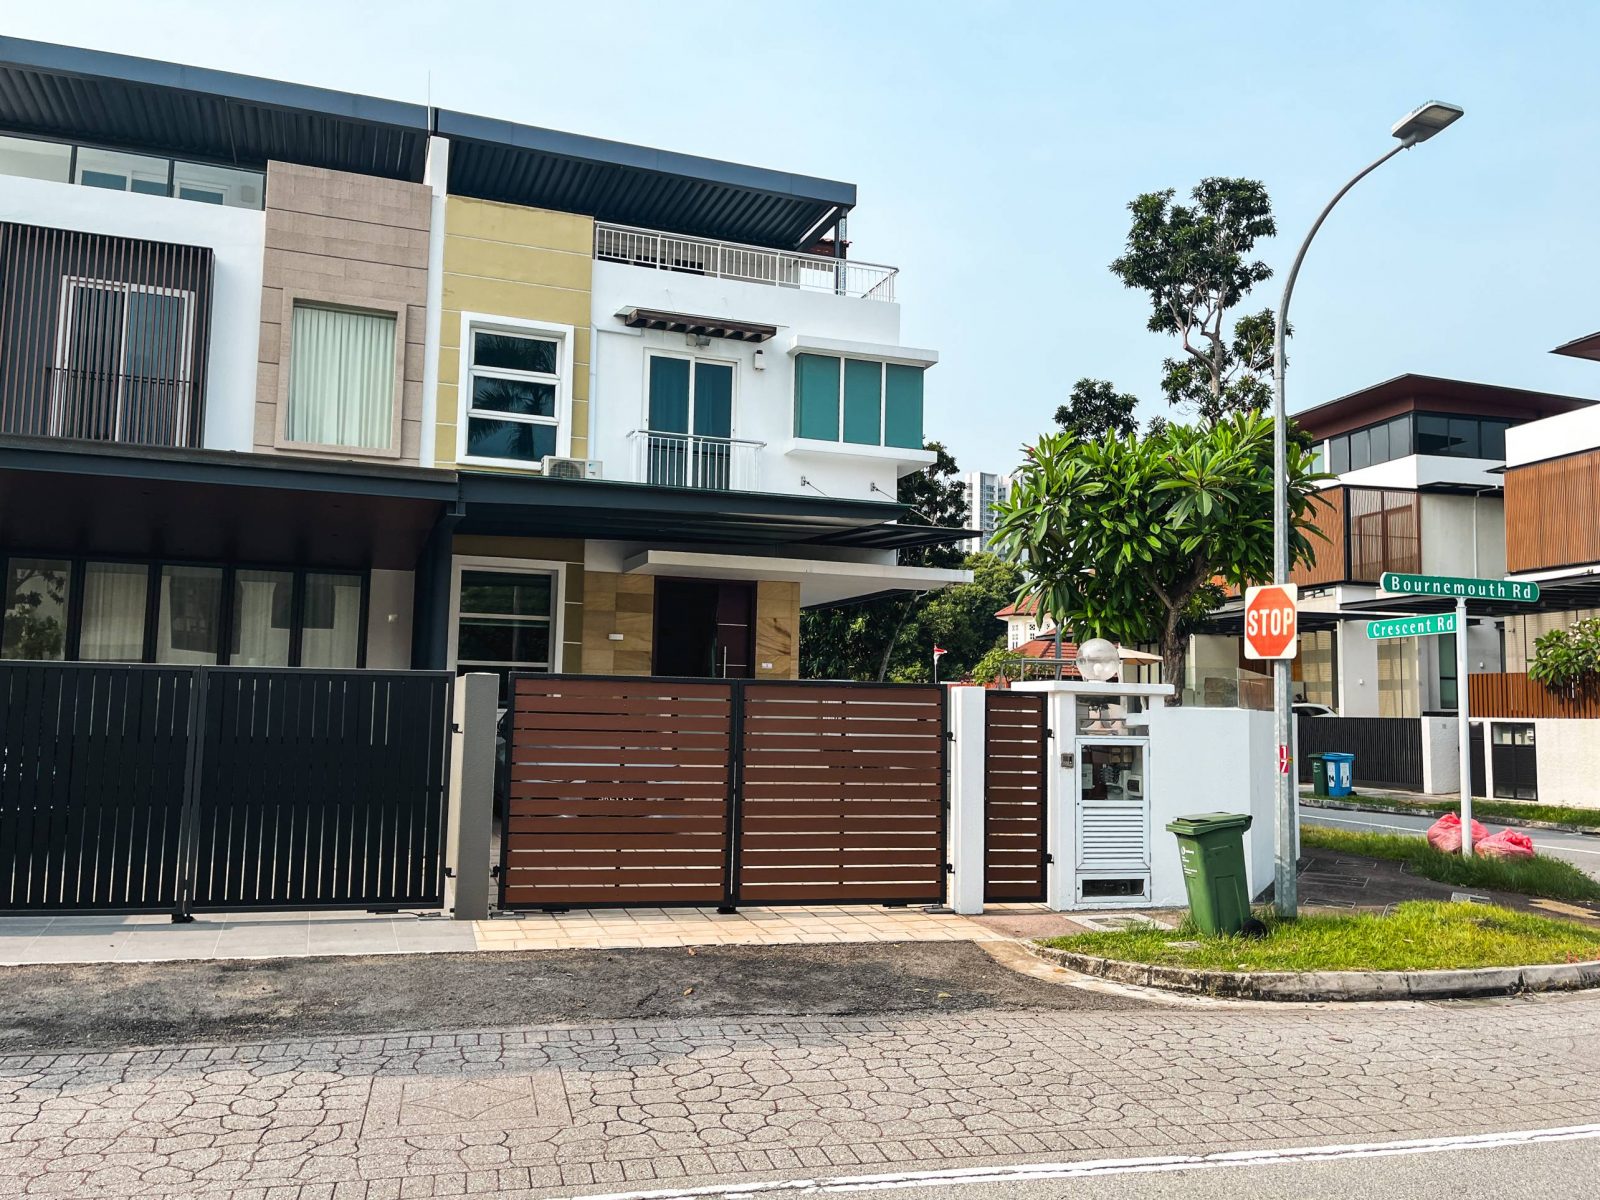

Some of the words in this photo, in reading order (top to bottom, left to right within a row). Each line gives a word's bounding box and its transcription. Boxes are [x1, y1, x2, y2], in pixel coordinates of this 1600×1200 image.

[1391, 575, 1506, 597] Bournemouth
[1512, 583, 1531, 599] Rd
[1247, 607, 1294, 637] STOP
[1372, 619, 1431, 637] Crescent
[1437, 616, 1454, 631] Rd
